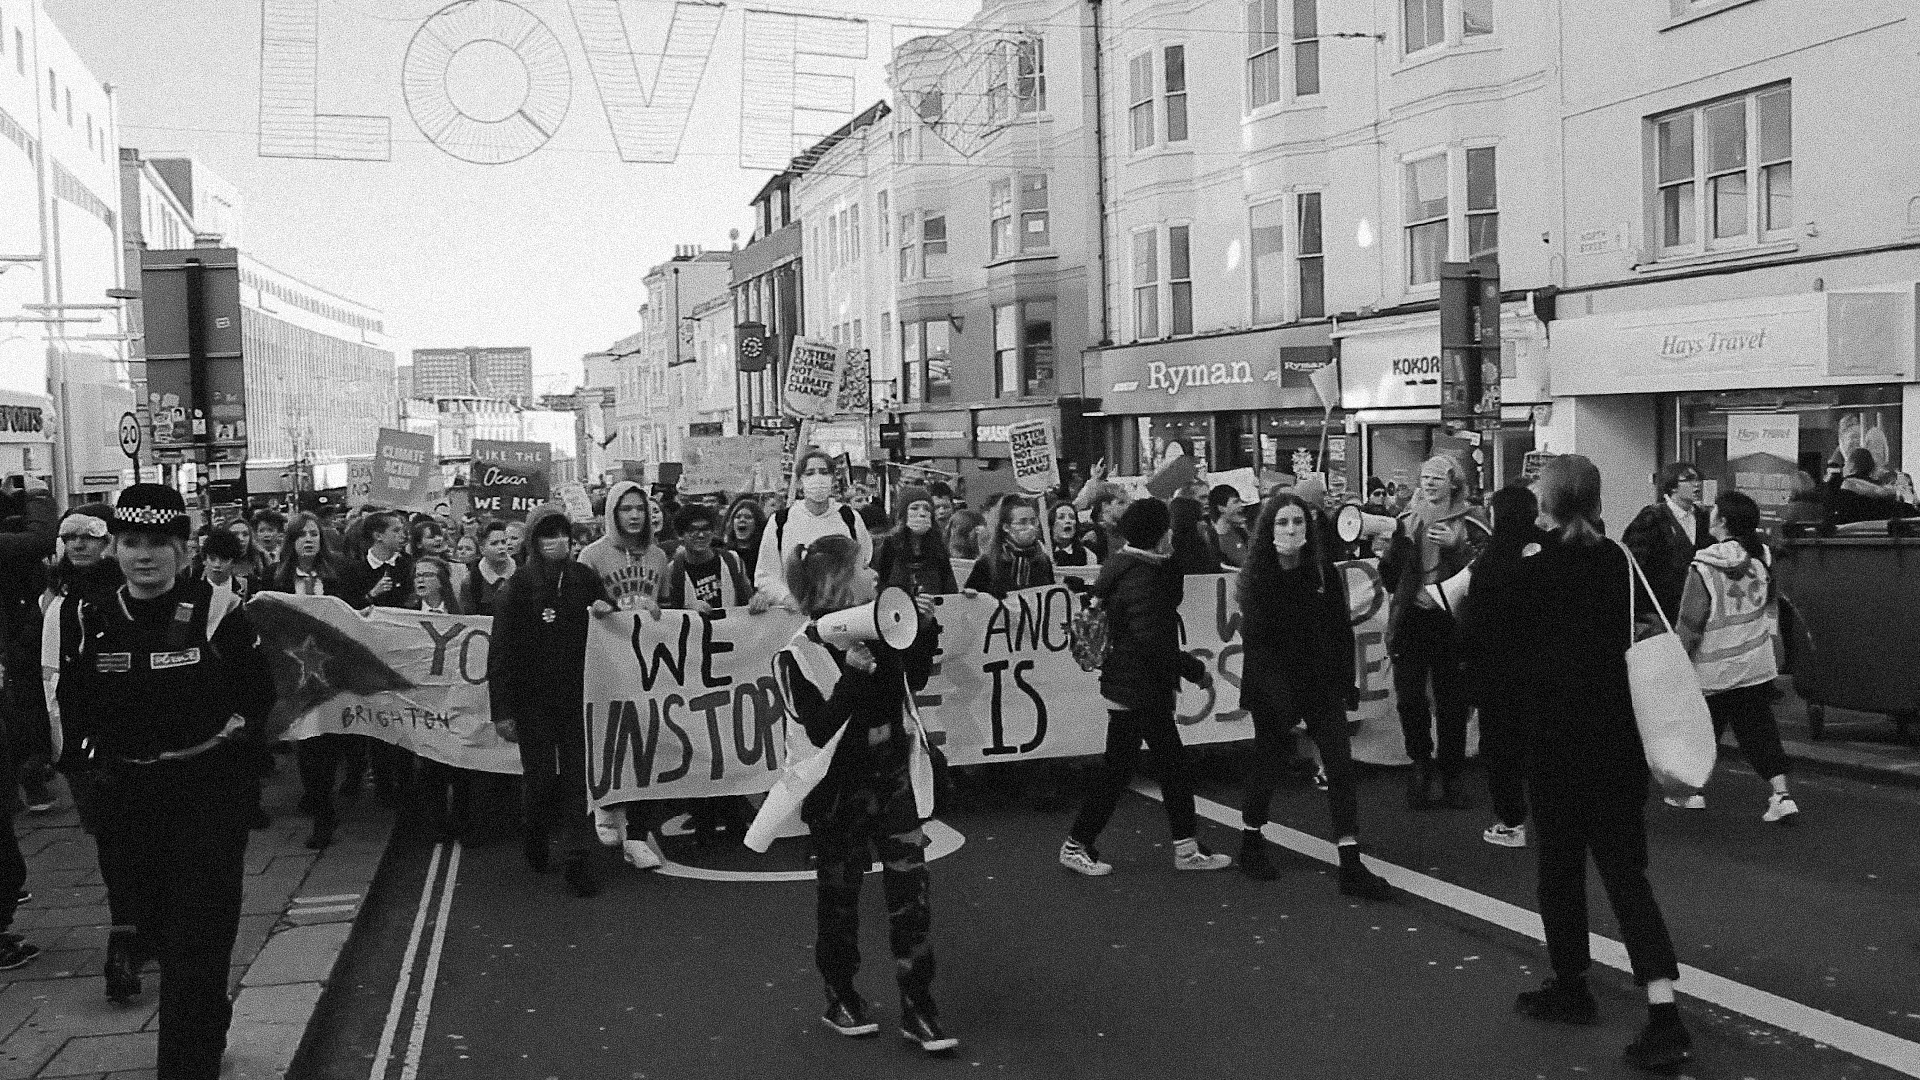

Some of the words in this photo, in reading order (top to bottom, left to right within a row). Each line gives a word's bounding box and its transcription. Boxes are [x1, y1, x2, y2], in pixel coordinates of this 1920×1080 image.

[258, 0, 869, 178] LOVE
[1661, 335, 1704, 359] Hays
[1706, 328, 1767, 353] Travel
[793, 356, 835, 371] CHANGE
[797, 346, 837, 363] SYSTEM
[791, 366, 812, 378] NOT
[1392, 356, 1440, 376] KOKOR
[789, 374, 834, 389] CLIMATE
[1146, 358, 1254, 395] Ryman
[788, 383, 830, 398] CHANGE
[122, 425, 137, 445] 20
[1011, 427, 1046, 443] SYSTEM
[1012, 438, 1048, 451] CHANGE
[383, 444, 425, 464] CLIMATE
[475, 449, 508, 463] LIKE
[515, 451, 543, 463] THE
[1014, 449, 1031, 461] NOT
[1016, 454, 1049, 469] CLIMATE
[483, 466, 528, 487] Ocean
[1017, 463, 1050, 478] CHANGE
[474, 496, 500, 511] WE
[983, 587, 1074, 654] ANO
[420, 620, 491, 686] YO
[631, 607, 734, 692] WE
[981, 659, 1049, 757] IS
[341, 706, 452, 731] BRIGHTON
[586, 676, 788, 800] UNSTOP
